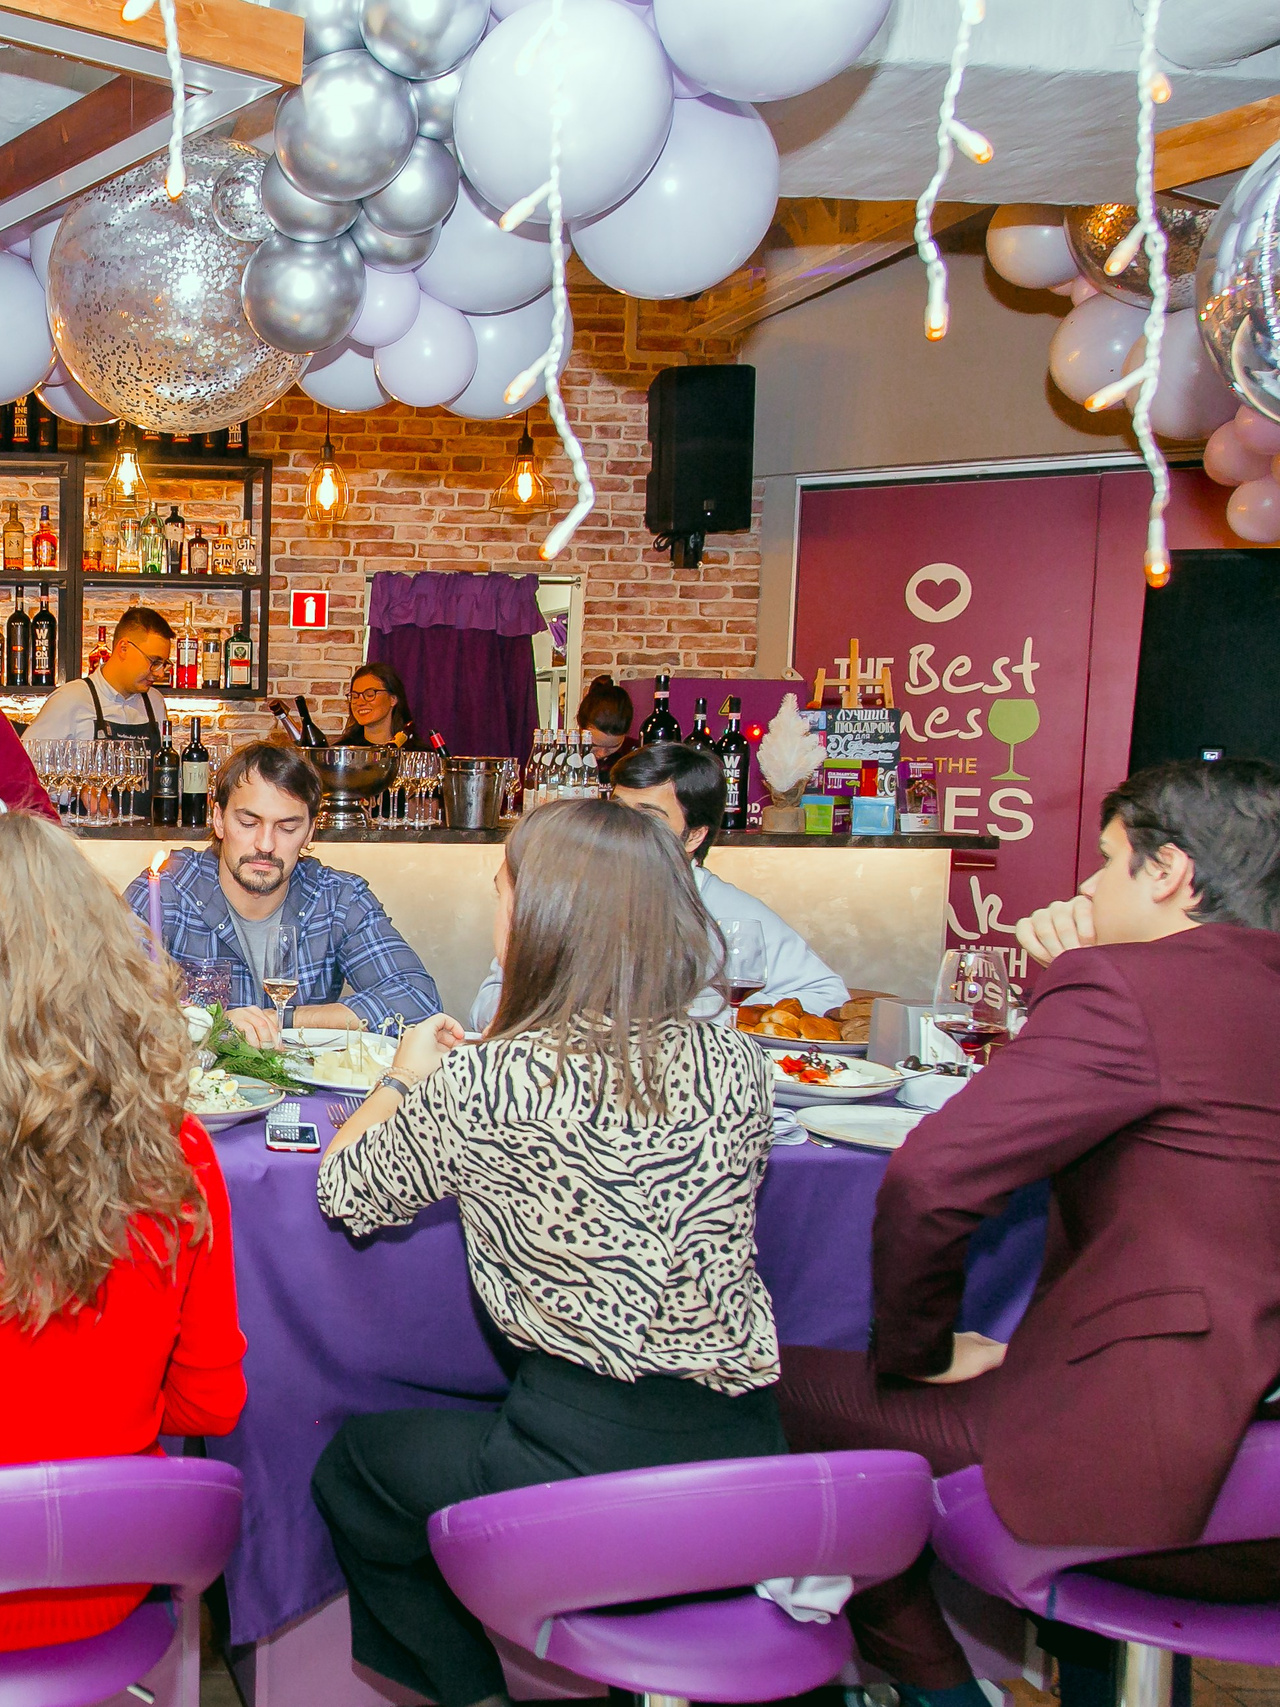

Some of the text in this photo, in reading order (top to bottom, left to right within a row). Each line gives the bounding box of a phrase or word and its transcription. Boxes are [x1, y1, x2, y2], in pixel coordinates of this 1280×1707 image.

[35, 629, 48, 640] W
[904, 637, 1041, 695] Best
[837, 708, 889, 721] ЛУЧШИЙ
[834, 721, 895, 734] ПОДАРОК
[723, 755, 740, 769] W
[934, 757, 978, 774] THE
[944, 787, 1034, 841] ES
